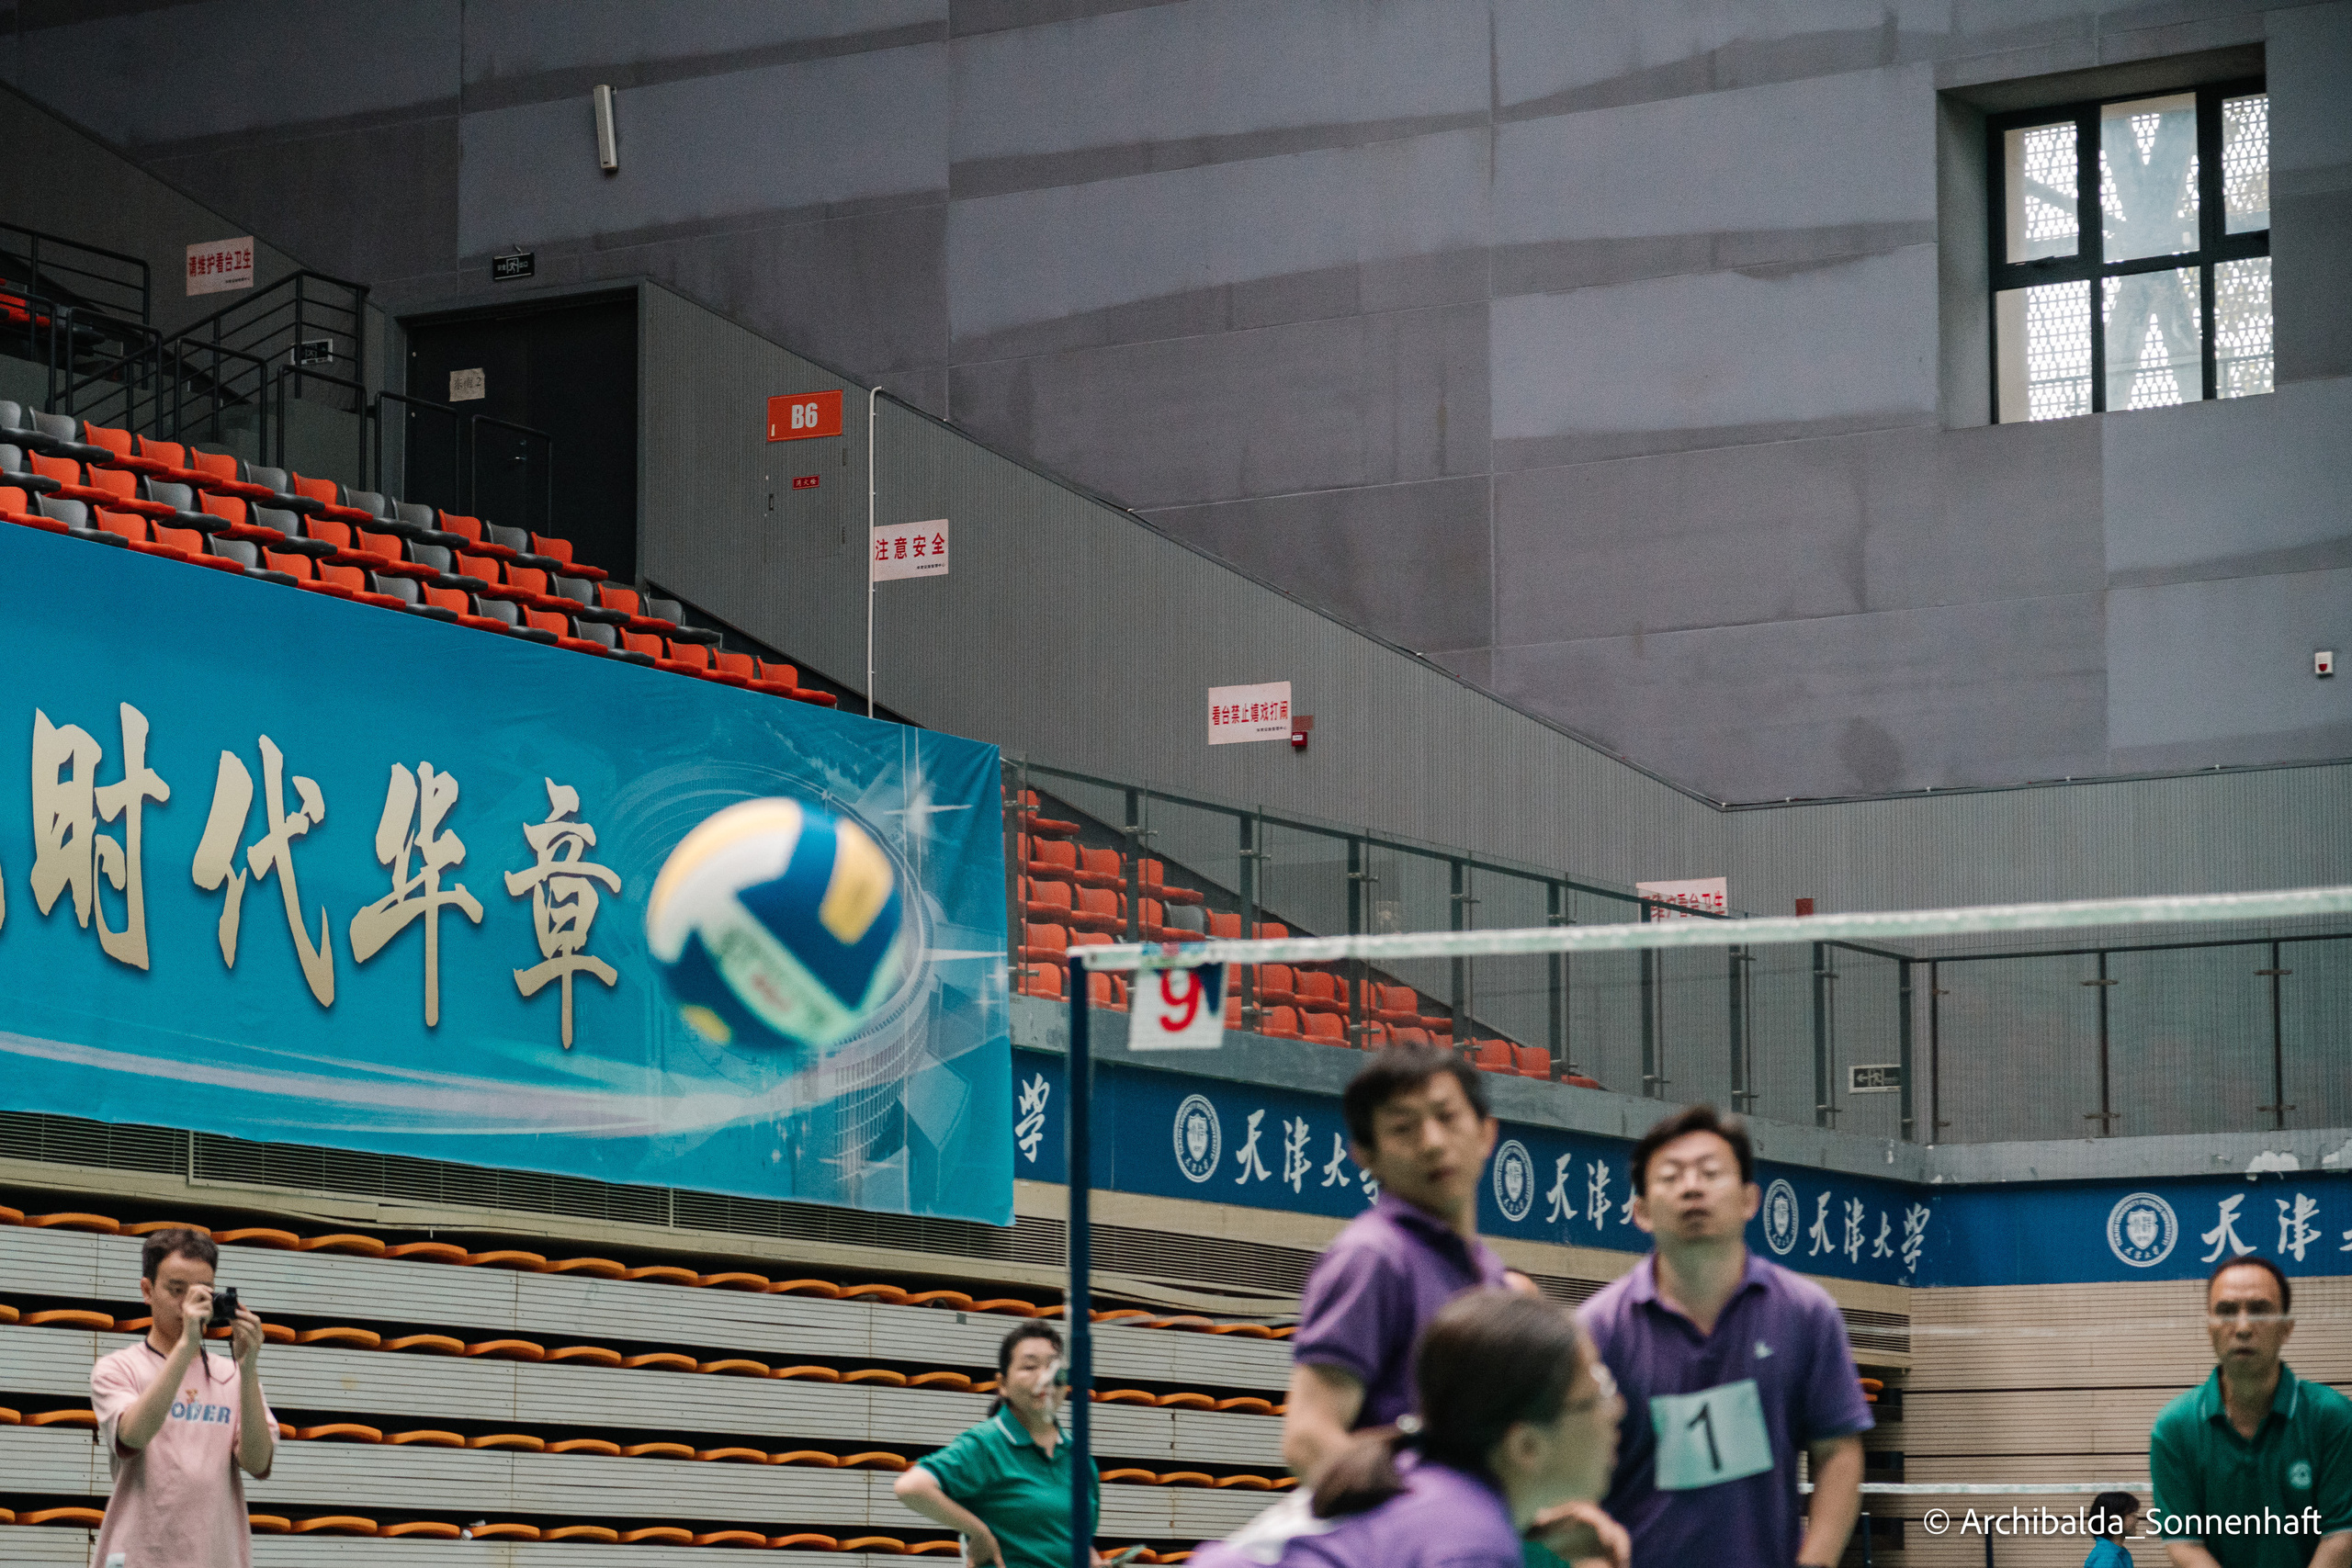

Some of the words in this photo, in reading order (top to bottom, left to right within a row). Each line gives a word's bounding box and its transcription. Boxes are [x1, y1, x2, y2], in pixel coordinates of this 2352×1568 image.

[791, 402, 819, 430] B6
[875, 532, 945, 561] 注意安全
[1212, 700, 1289, 726] 看台禁止嬉戏打闹
[1159, 967, 1202, 1032] 9
[1808, 1191, 1930, 1273] 天津大学
[1688, 1404, 1722, 1472] 1
